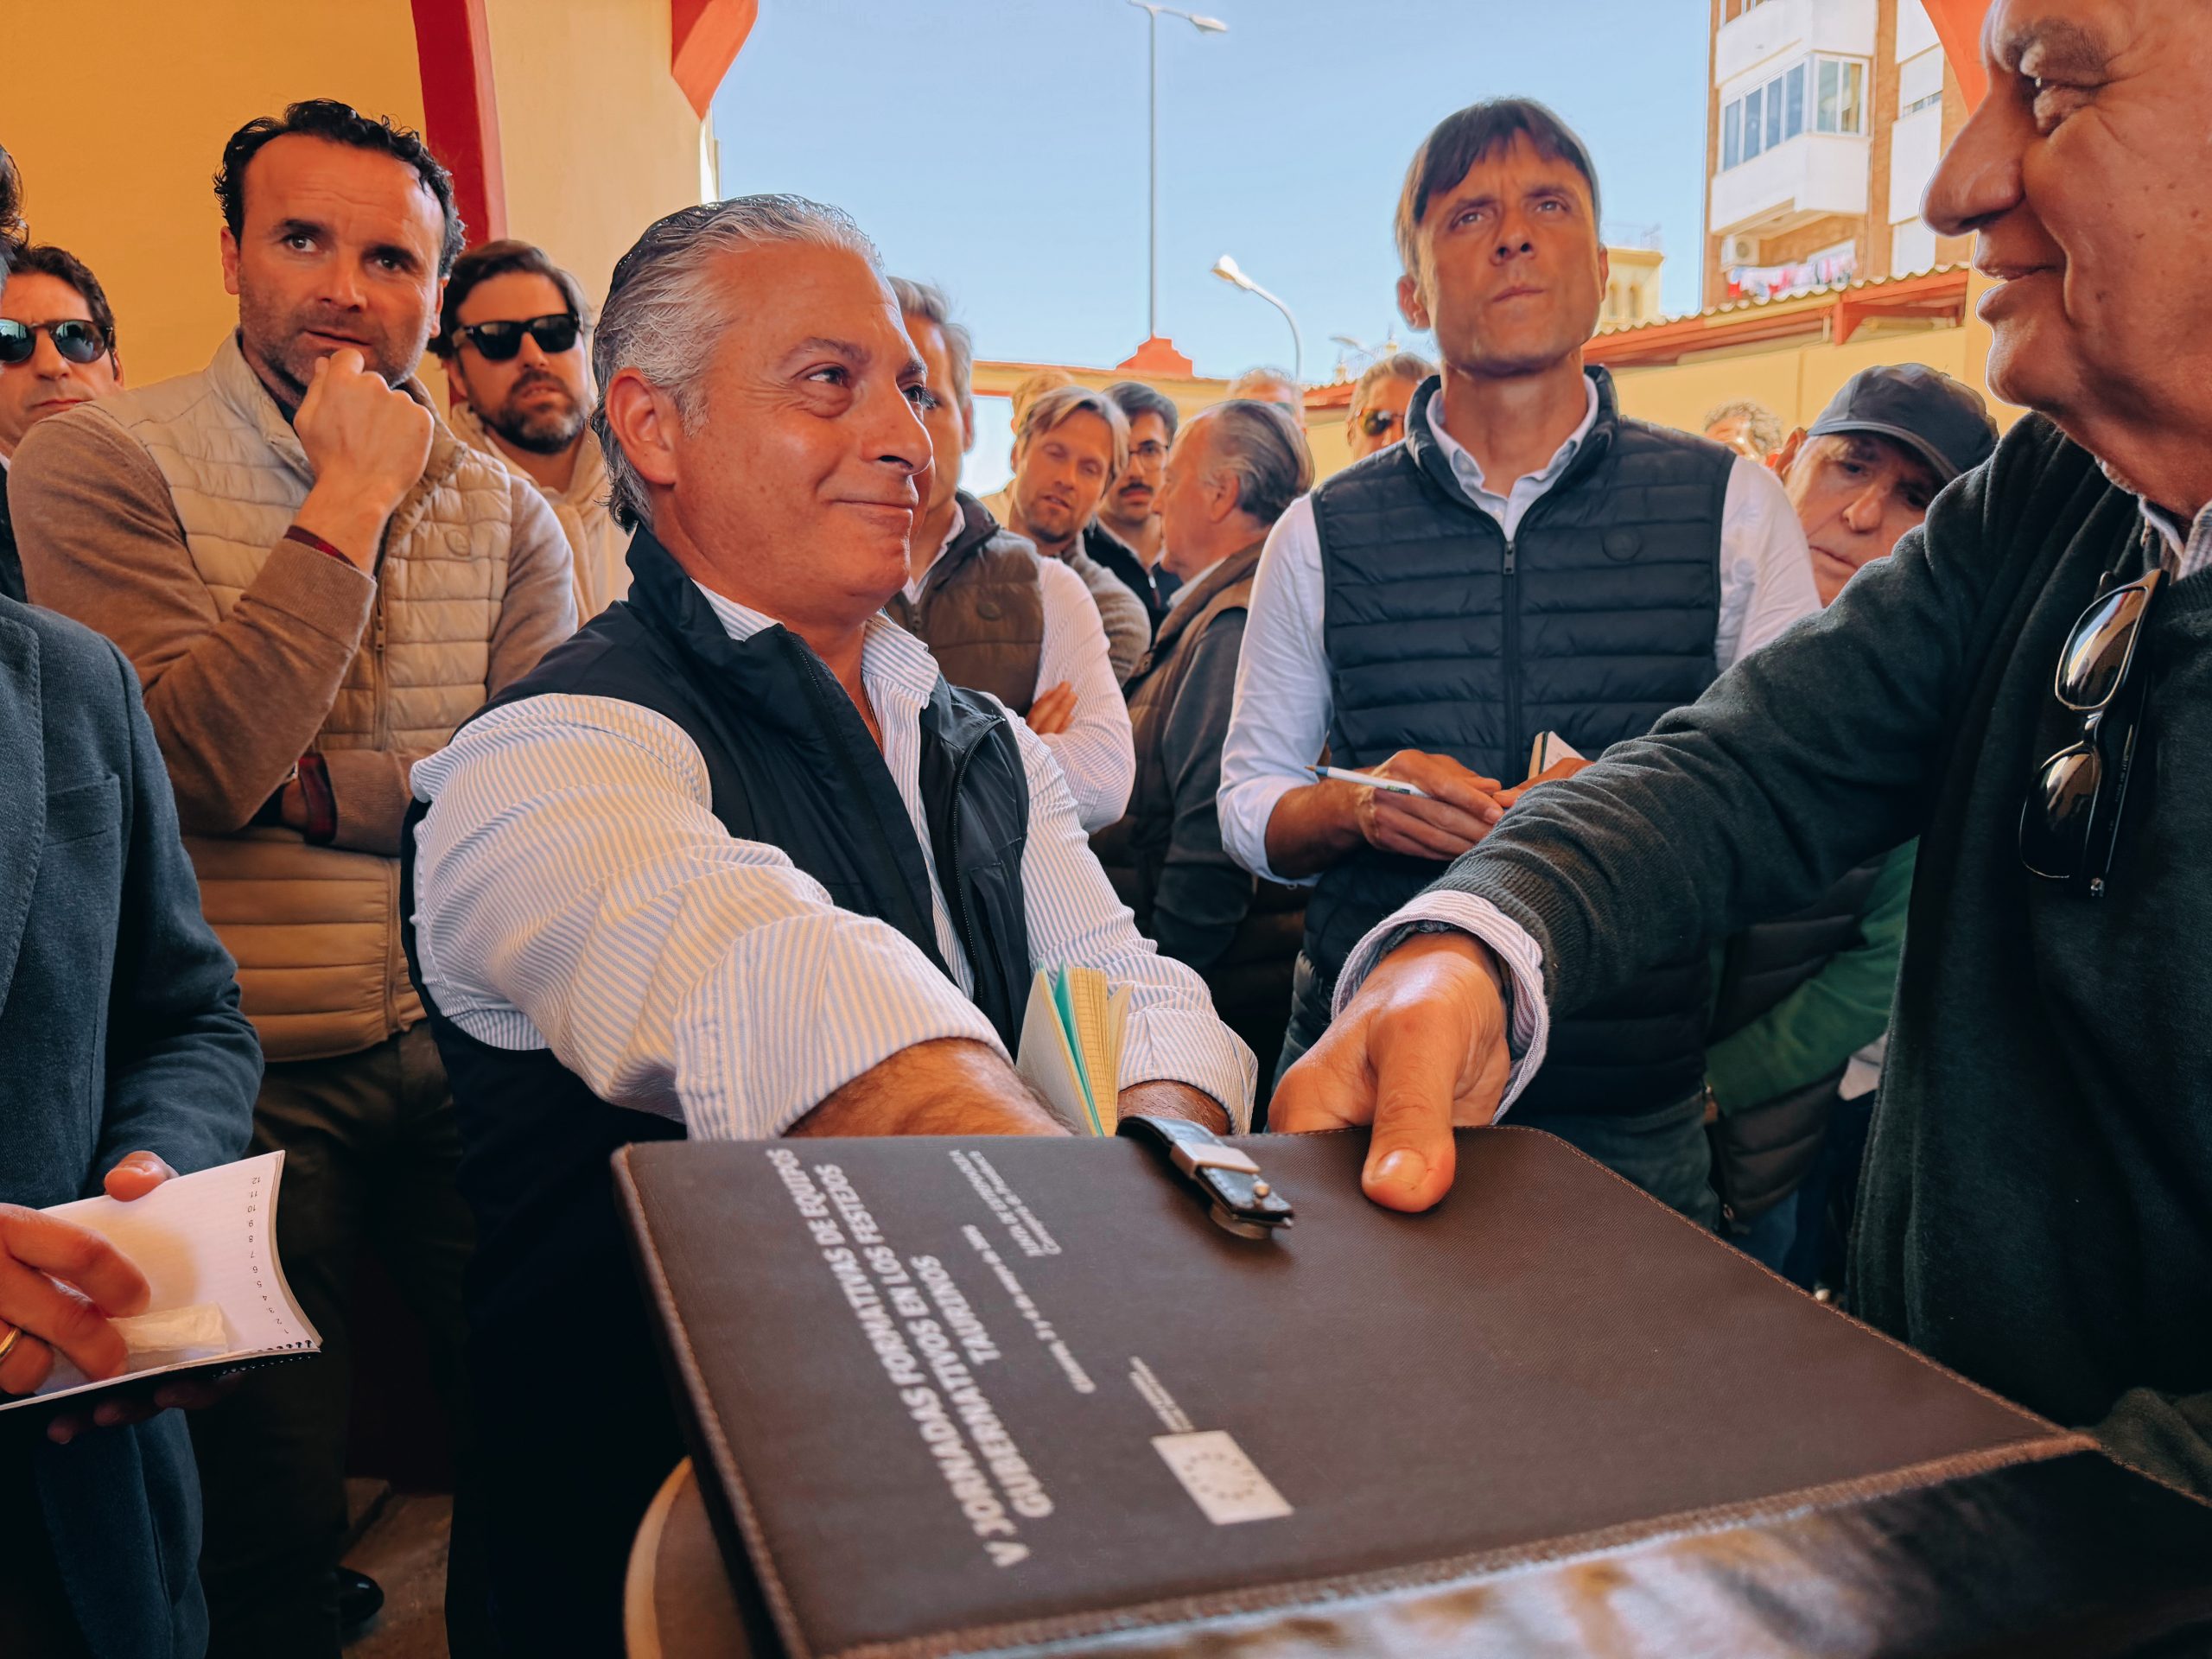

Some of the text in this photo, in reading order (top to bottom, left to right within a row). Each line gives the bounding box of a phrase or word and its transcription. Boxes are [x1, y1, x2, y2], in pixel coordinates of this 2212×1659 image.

[813, 1164, 885, 1244] FESTEJOS
[864, 1245, 911, 1285] LOS
[887, 1286, 930, 1317] EN
[910, 1255, 1001, 1364] TAURINOS
[766, 1148, 1031, 1567] V JORNADAS FORMATIVAS DE EQUIPOS
[906, 1318, 1055, 1518] GUBERNATIVOS
